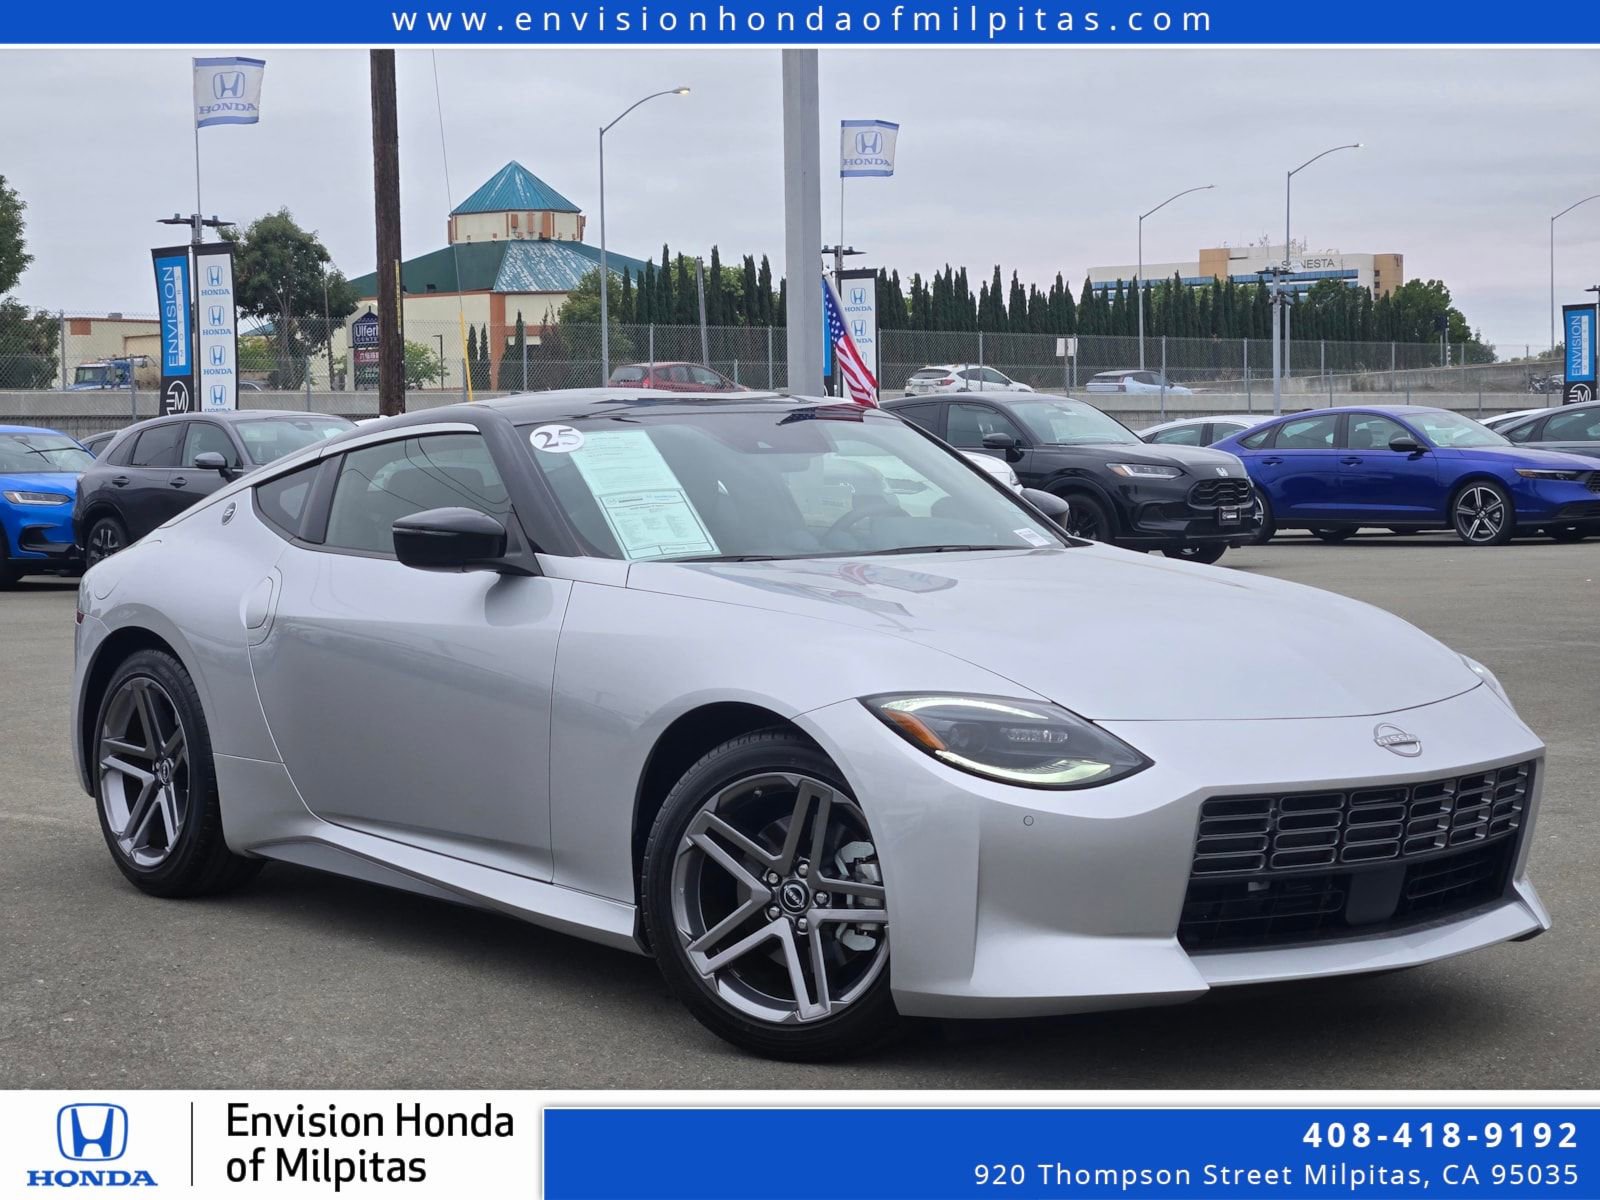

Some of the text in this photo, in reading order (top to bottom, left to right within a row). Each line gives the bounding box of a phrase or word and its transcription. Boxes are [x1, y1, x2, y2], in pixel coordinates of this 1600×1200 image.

[199, 103, 257, 114] HONDA
[843, 158, 892, 167] HONDA
[1281, 258, 1335, 270] SNESTA
[163, 267, 178, 367] ENVISION
[1570, 315, 1583, 377] ENVISION
[535, 428, 581, 449] 25
